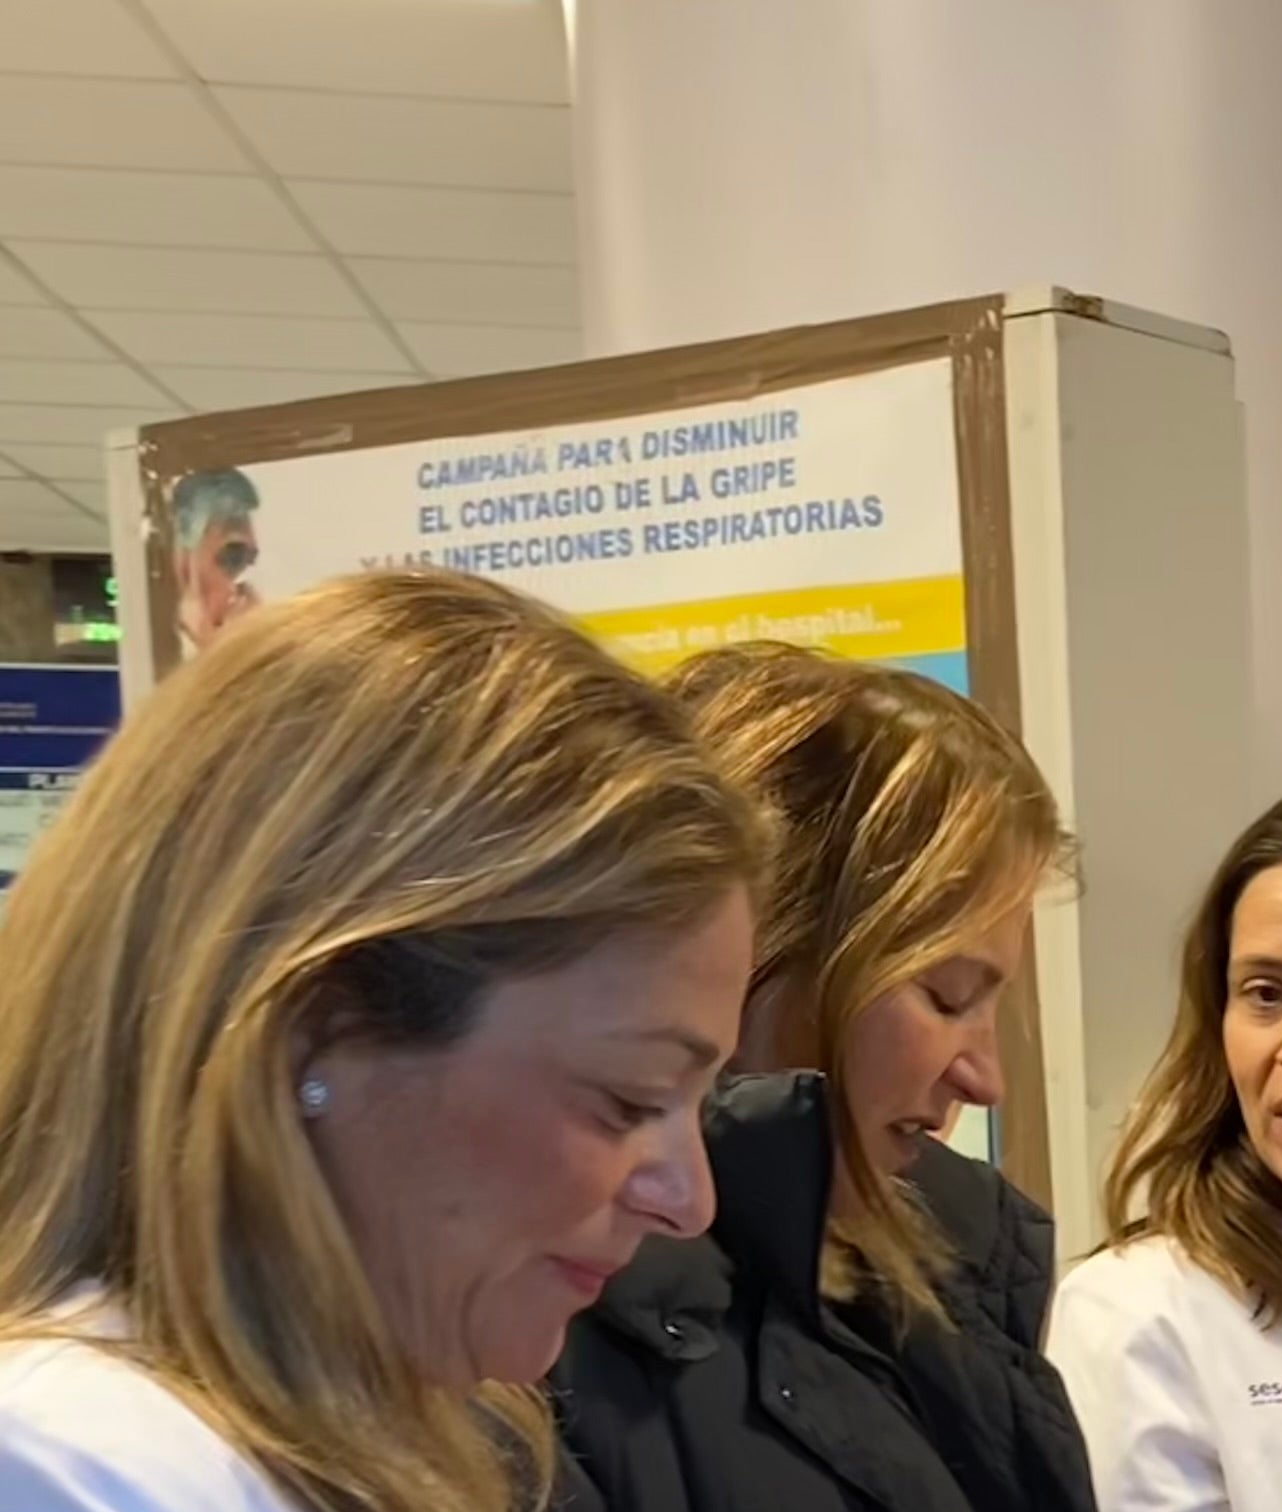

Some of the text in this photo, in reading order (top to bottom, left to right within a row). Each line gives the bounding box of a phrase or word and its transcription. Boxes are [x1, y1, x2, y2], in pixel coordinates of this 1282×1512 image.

[416, 441, 548, 490] CAMPAÑA
[641, 409, 799, 461] DISMINUIR
[419, 457, 796, 535] EL CONTAGIO DE LA GRIPE
[443, 527, 633, 571] INFECCIONES
[643, 494, 884, 555] RESPIRATORIAS
